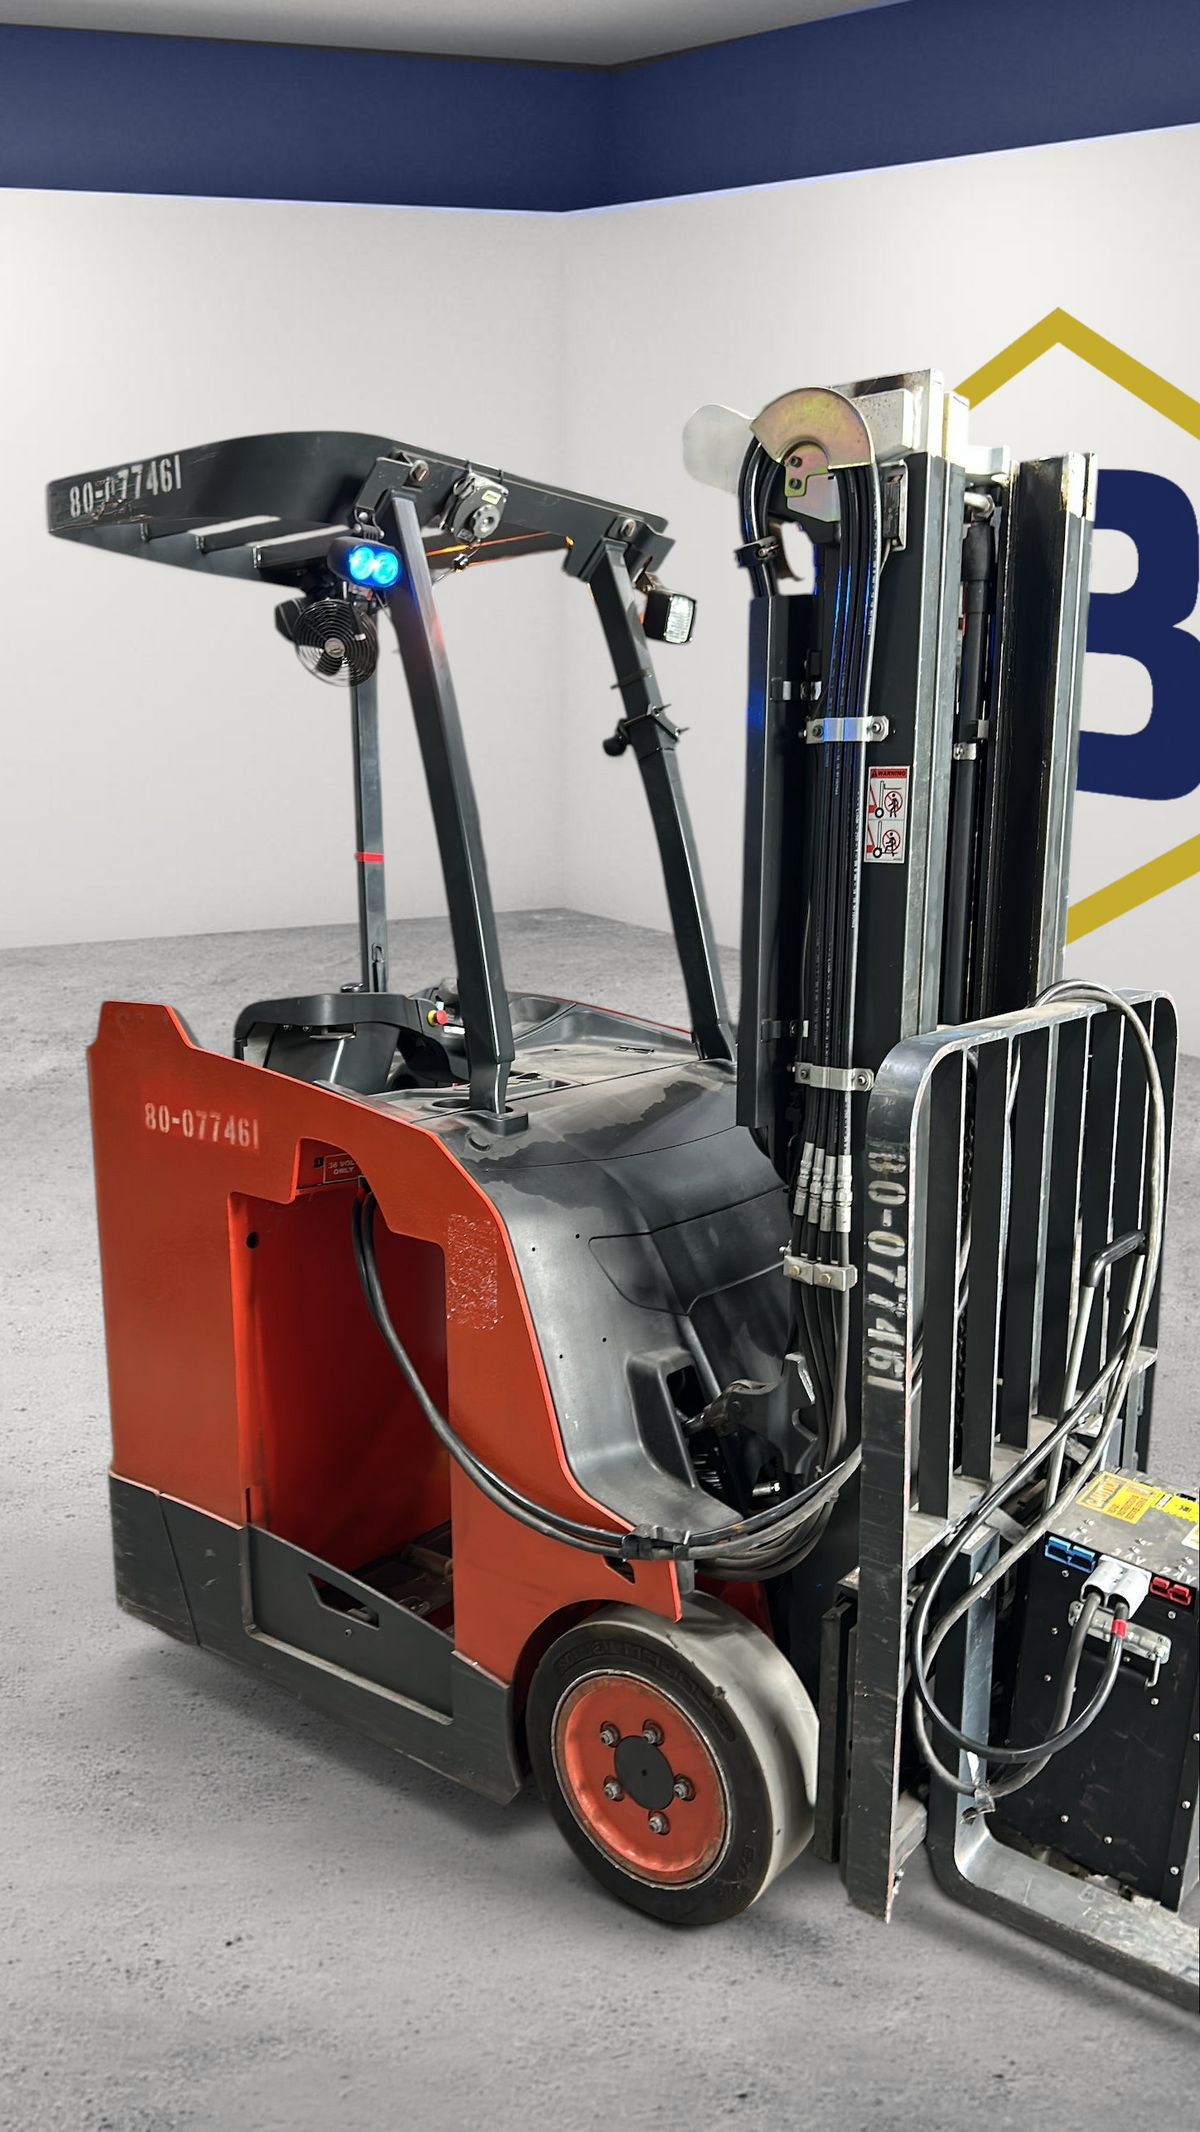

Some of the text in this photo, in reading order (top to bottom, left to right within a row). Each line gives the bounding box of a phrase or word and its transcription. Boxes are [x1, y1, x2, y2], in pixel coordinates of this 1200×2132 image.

[1076, 469, 1200, 801] B
[878, 769, 906, 777] WARNING
[145, 1102, 259, 1149] 80-077461
[333, 1166, 354, 1175] ONLY
[867, 1150, 907, 1391] 80-077461
